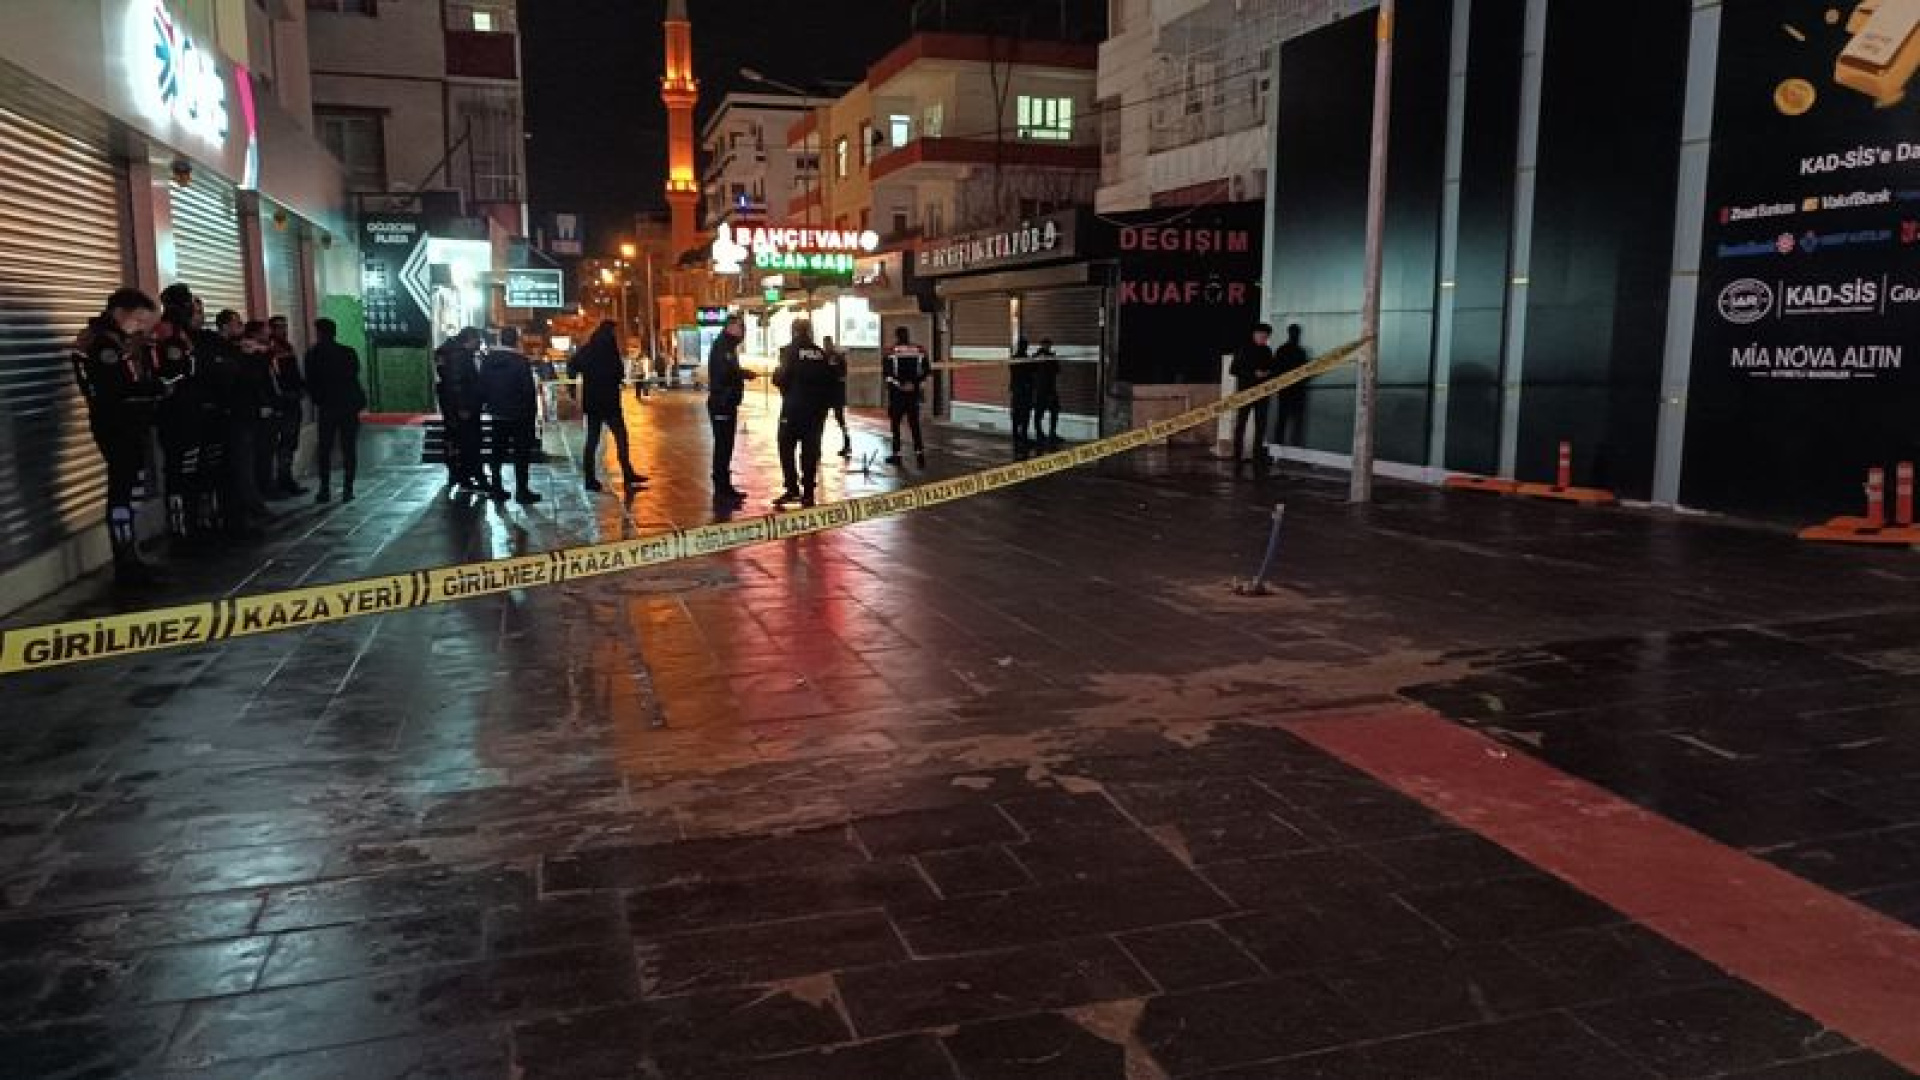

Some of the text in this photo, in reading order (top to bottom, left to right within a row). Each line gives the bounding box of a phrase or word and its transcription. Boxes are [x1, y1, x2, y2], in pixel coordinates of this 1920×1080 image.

[1800, 146, 1892, 175] KAD-SİS'e
[1786, 277, 1878, 306] KAD-SİS
[1732, 341, 1902, 368] MİA NOVA ALTIN
[23, 615, 201, 664] GİRİLMEZ
[242, 596, 331, 630] KAZA
[337, 577, 403, 614] YERİ
[443, 560, 546, 597] GİRİLMEZ
